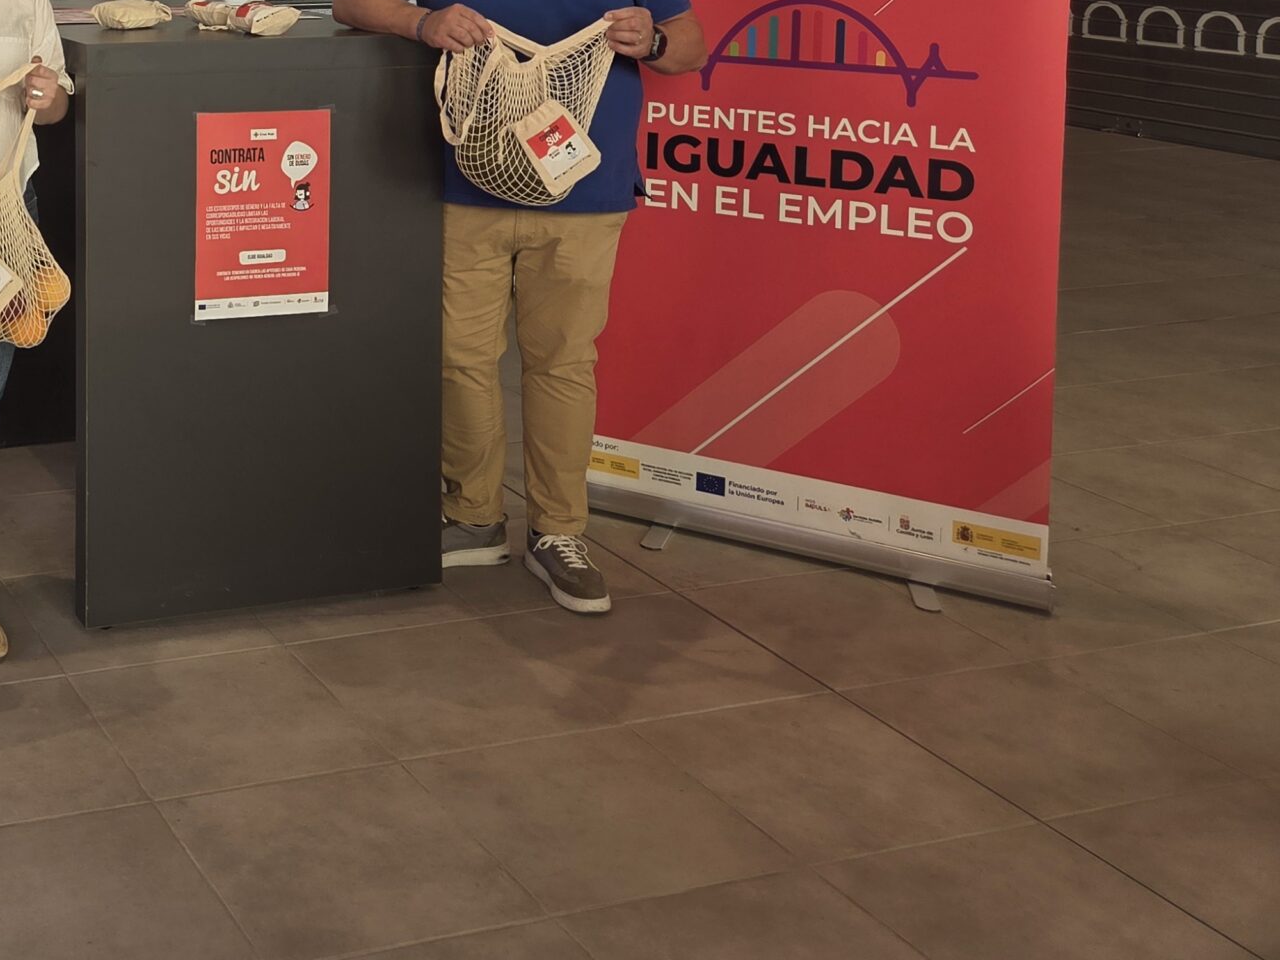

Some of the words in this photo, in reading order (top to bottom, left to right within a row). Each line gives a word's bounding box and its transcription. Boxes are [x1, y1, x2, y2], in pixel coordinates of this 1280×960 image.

[646, 101, 797, 136] PUENTES
[807, 116, 918, 148] HACIA
[930, 127, 976, 153] LA
[210, 147, 265, 165] CONTRATA
[646, 132, 976, 202] IGUALDAD
[214, 166, 261, 195] sin
[645, 178, 699, 213] EN
[715, 185, 764, 220] EL
[778, 193, 974, 244] EMPLEO
[728, 481, 765, 494] Financiado
[736, 490, 755, 499] Unión
[757, 495, 785, 505] Europea
